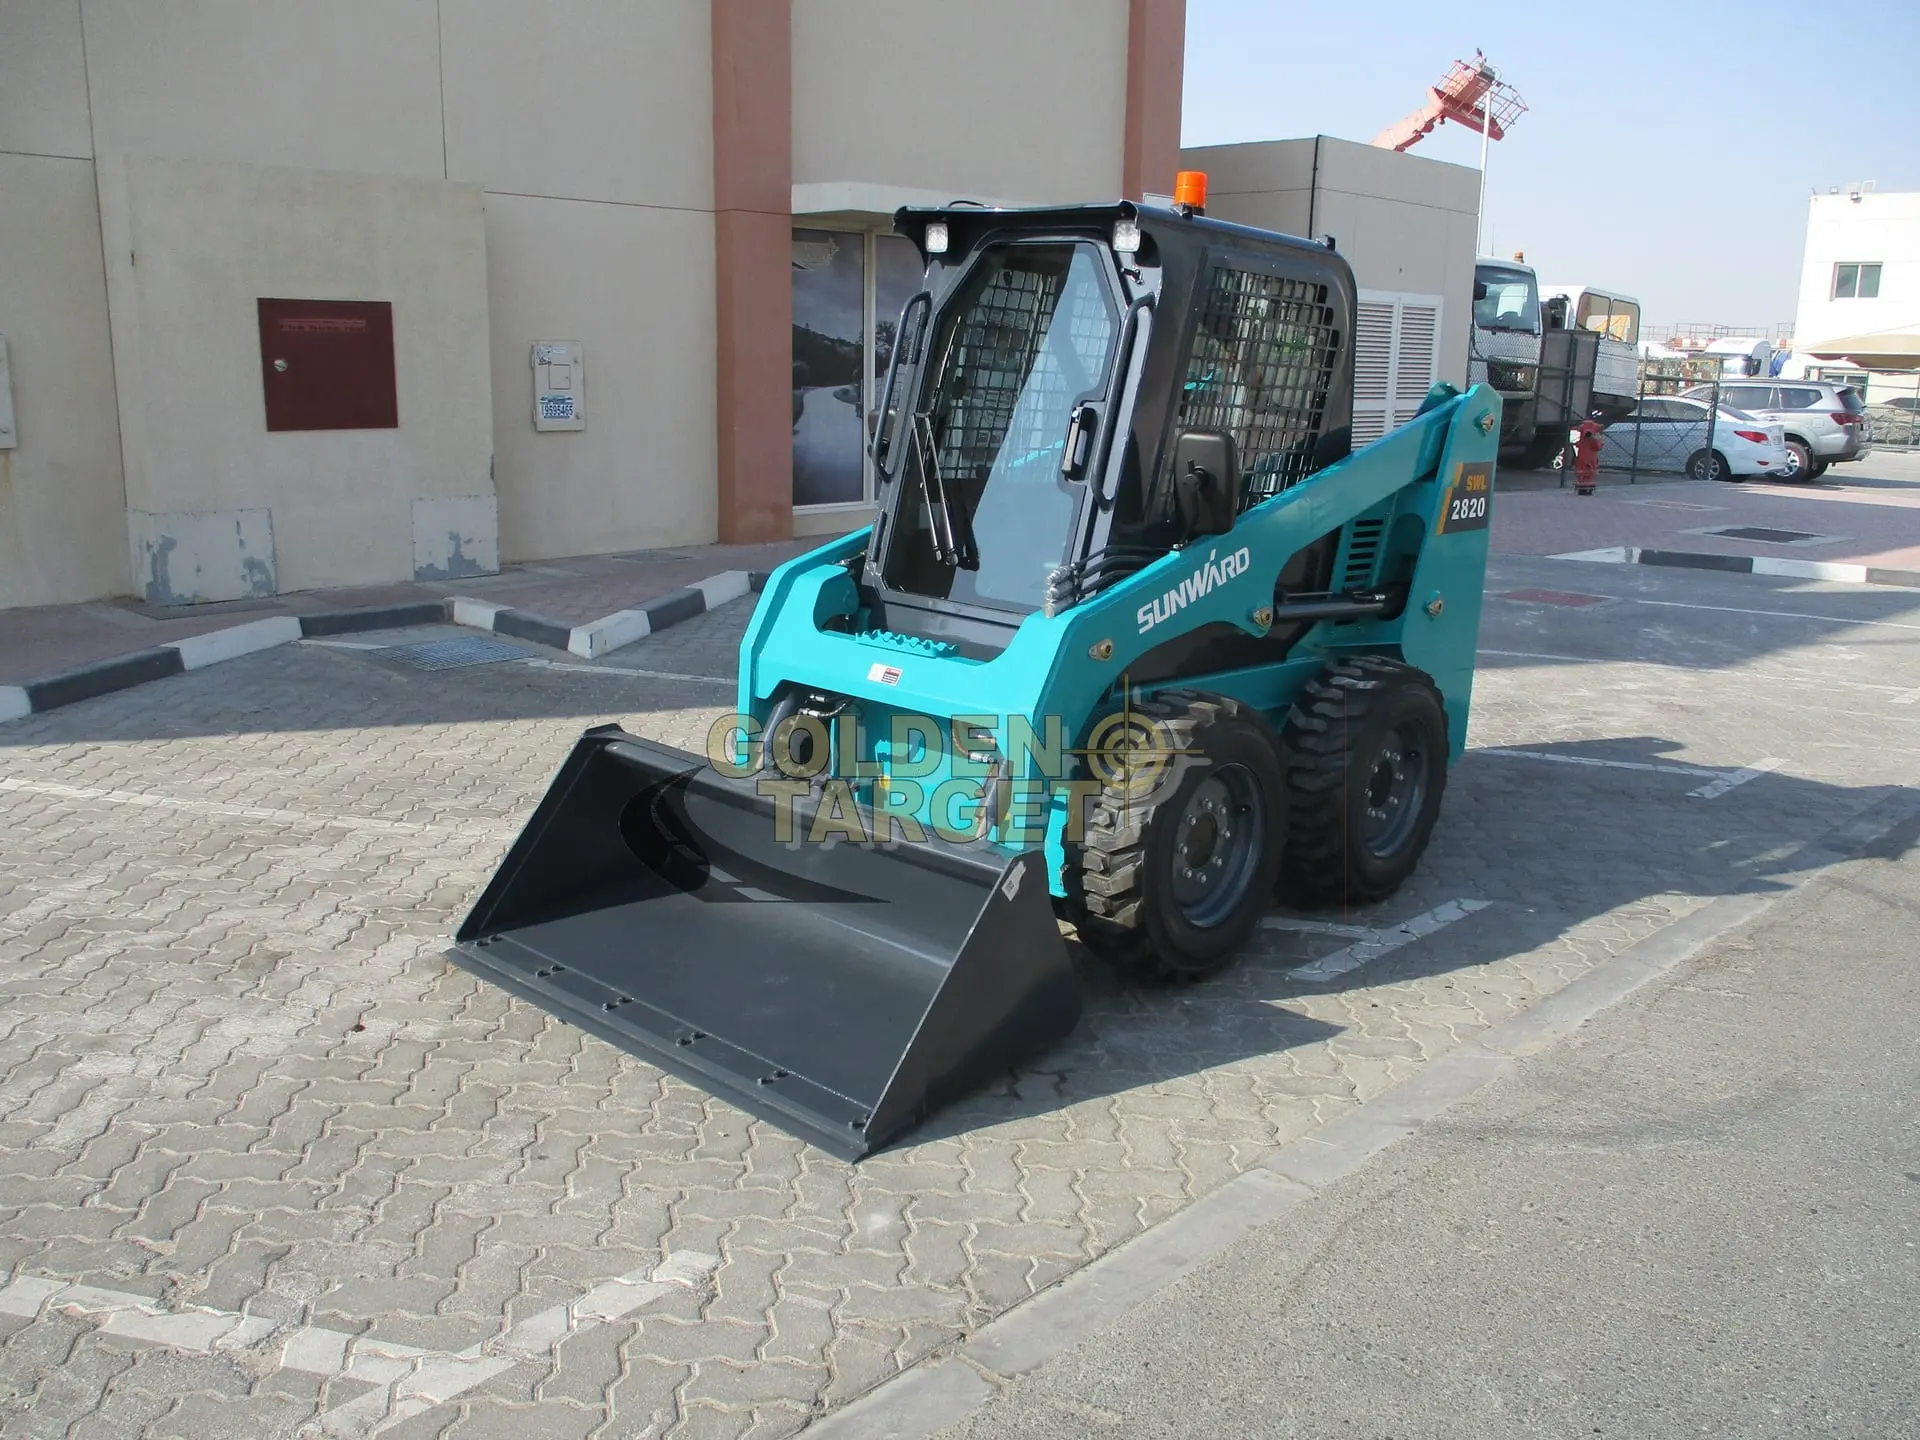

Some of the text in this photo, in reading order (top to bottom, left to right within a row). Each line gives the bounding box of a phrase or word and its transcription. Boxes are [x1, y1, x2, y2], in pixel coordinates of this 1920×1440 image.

[1466, 474, 1487, 491] SWL
[1451, 497, 1486, 520] 2820
[1137, 547, 1250, 634] SUNWARD
